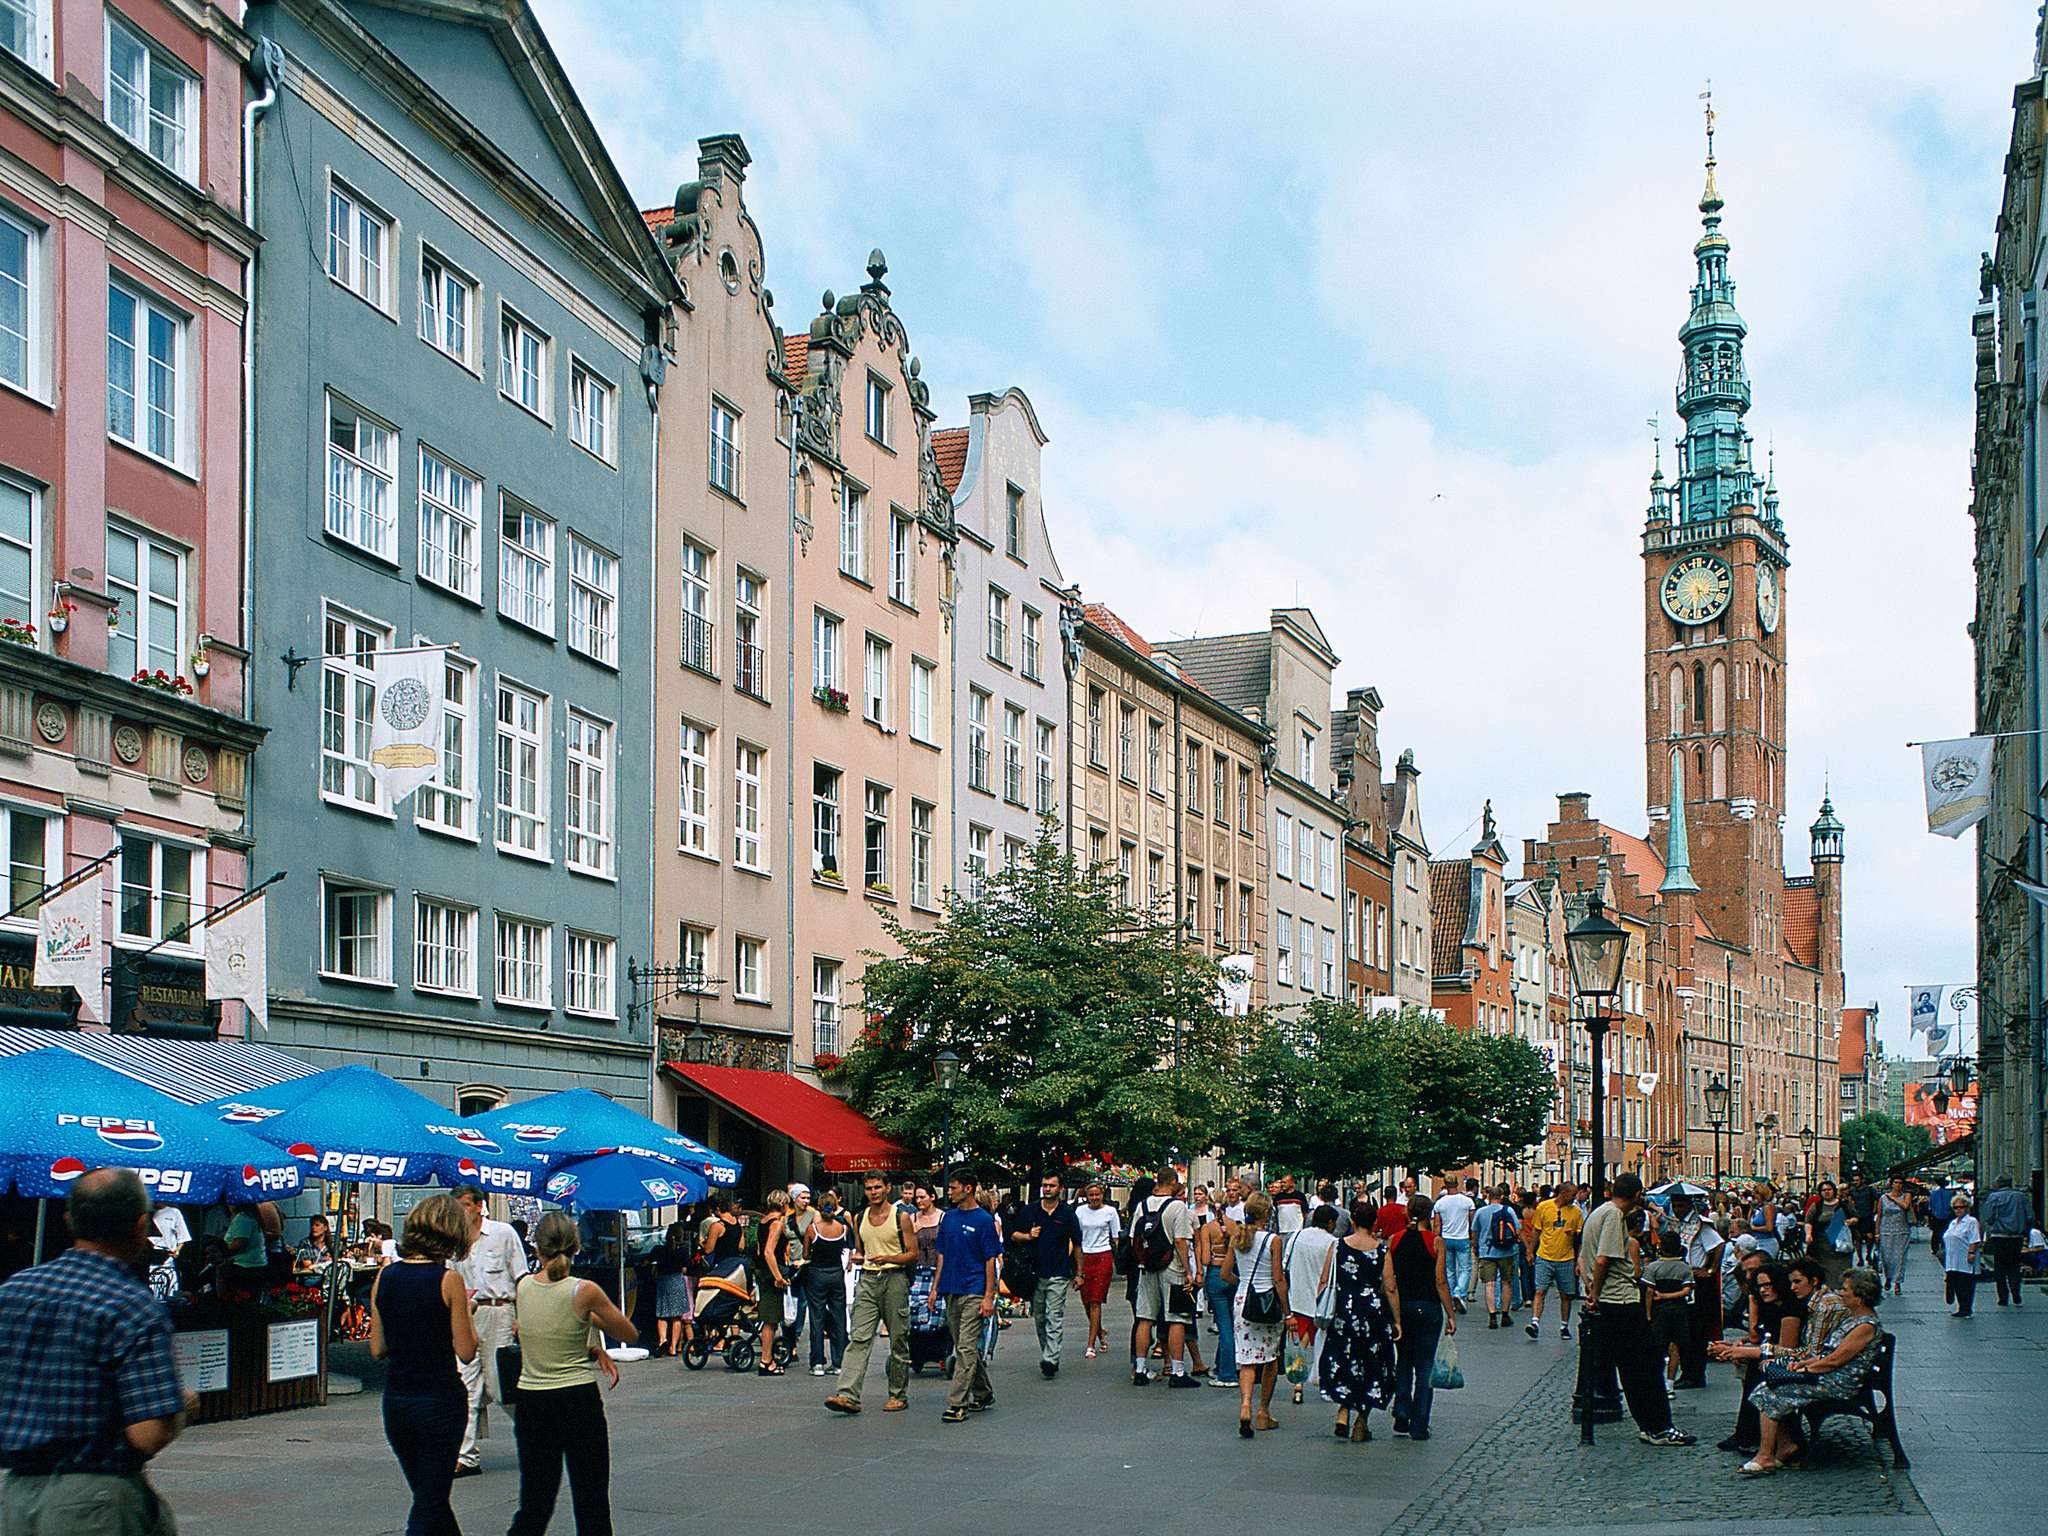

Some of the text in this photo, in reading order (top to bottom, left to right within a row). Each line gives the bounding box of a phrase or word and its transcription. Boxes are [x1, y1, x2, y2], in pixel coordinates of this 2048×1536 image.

[142, 984, 209, 1008] RESTAURAN
[217, 1102, 287, 1117] PEPSI
[57, 1113, 155, 1132] PEPSI
[425, 1124, 485, 1140] PEPSI
[502, 1123, 567, 1135] PEPSI
[320, 1151, 408, 1177] PEPSI
[260, 1165, 299, 1192] PEPSI
[480, 1165, 532, 1190] PEPSI
